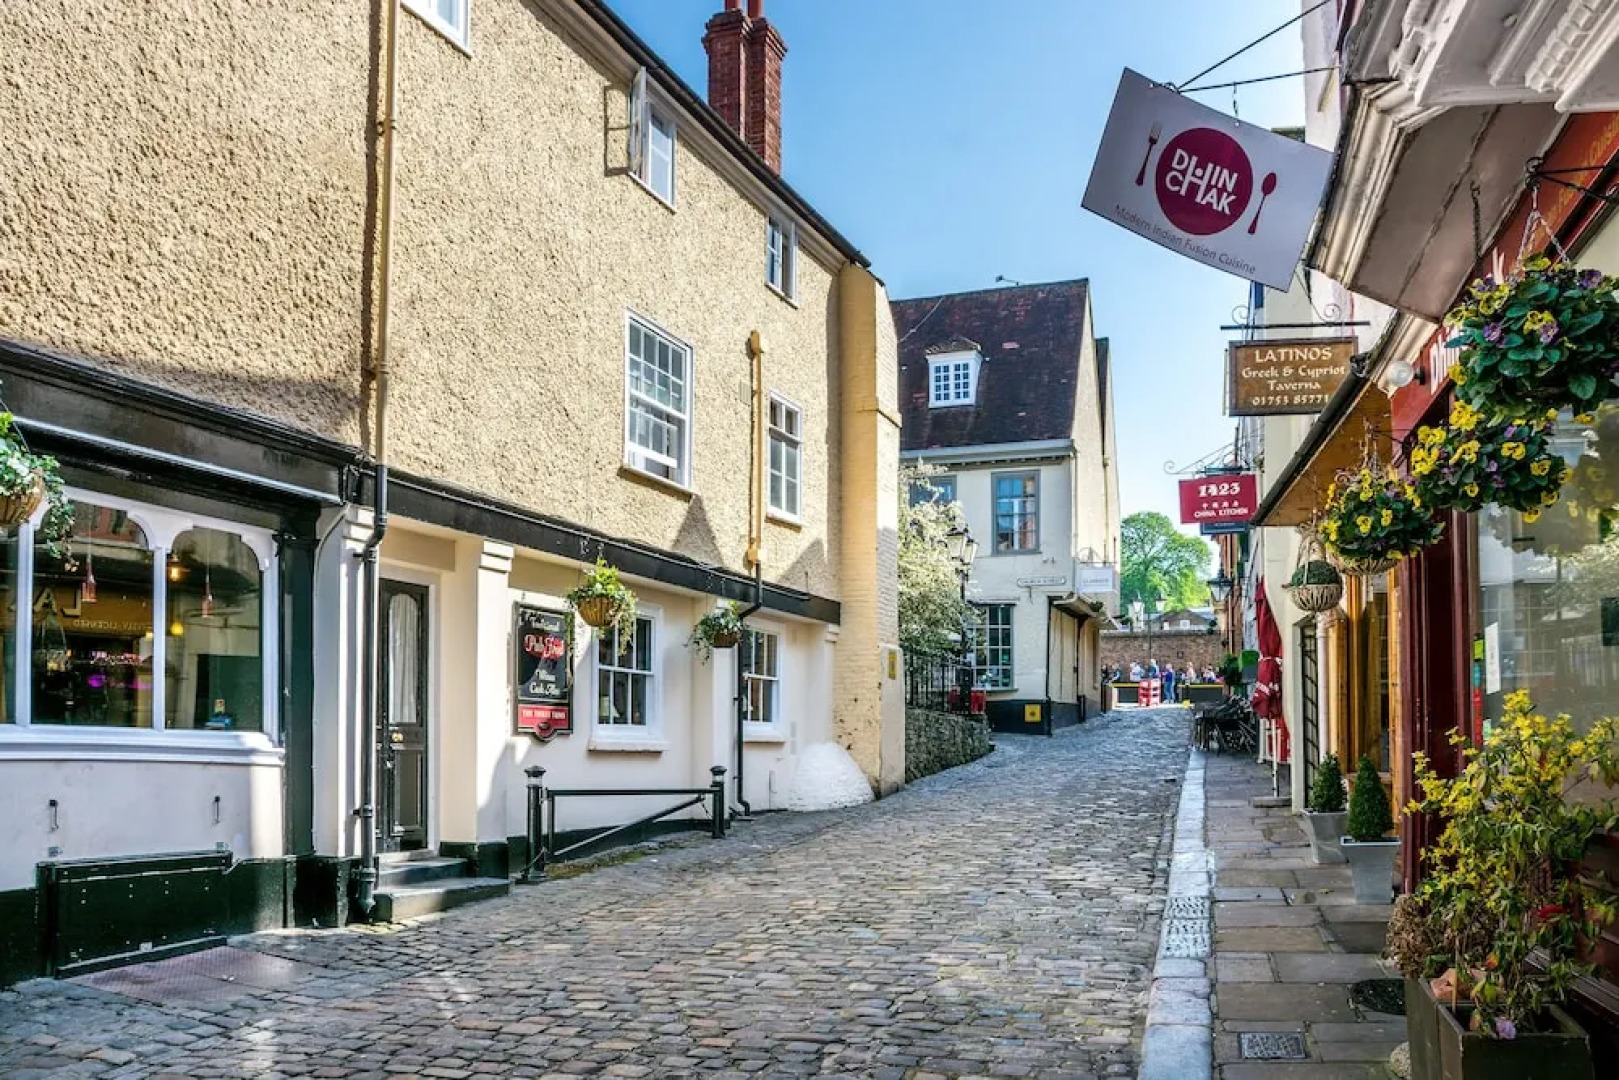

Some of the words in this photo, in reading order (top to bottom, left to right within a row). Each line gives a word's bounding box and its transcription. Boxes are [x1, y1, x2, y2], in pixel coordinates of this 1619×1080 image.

[1172, 148, 1239, 193] DHIN
[1165, 168, 1239, 216] CHAK
[1115, 204, 1150, 230] Modern
[1152, 224, 1182, 246] Indian
[1184, 239, 1216, 260] Fusion
[1219, 254, 1256, 274] Cuisine
[1255, 346, 1332, 363] LATINOS
[1241, 366, 1279, 378] Greek
[1283, 366, 1295, 376] &
[1298, 364, 1345, 380] Cypriot
[1267, 380, 1322, 392] Taverna
